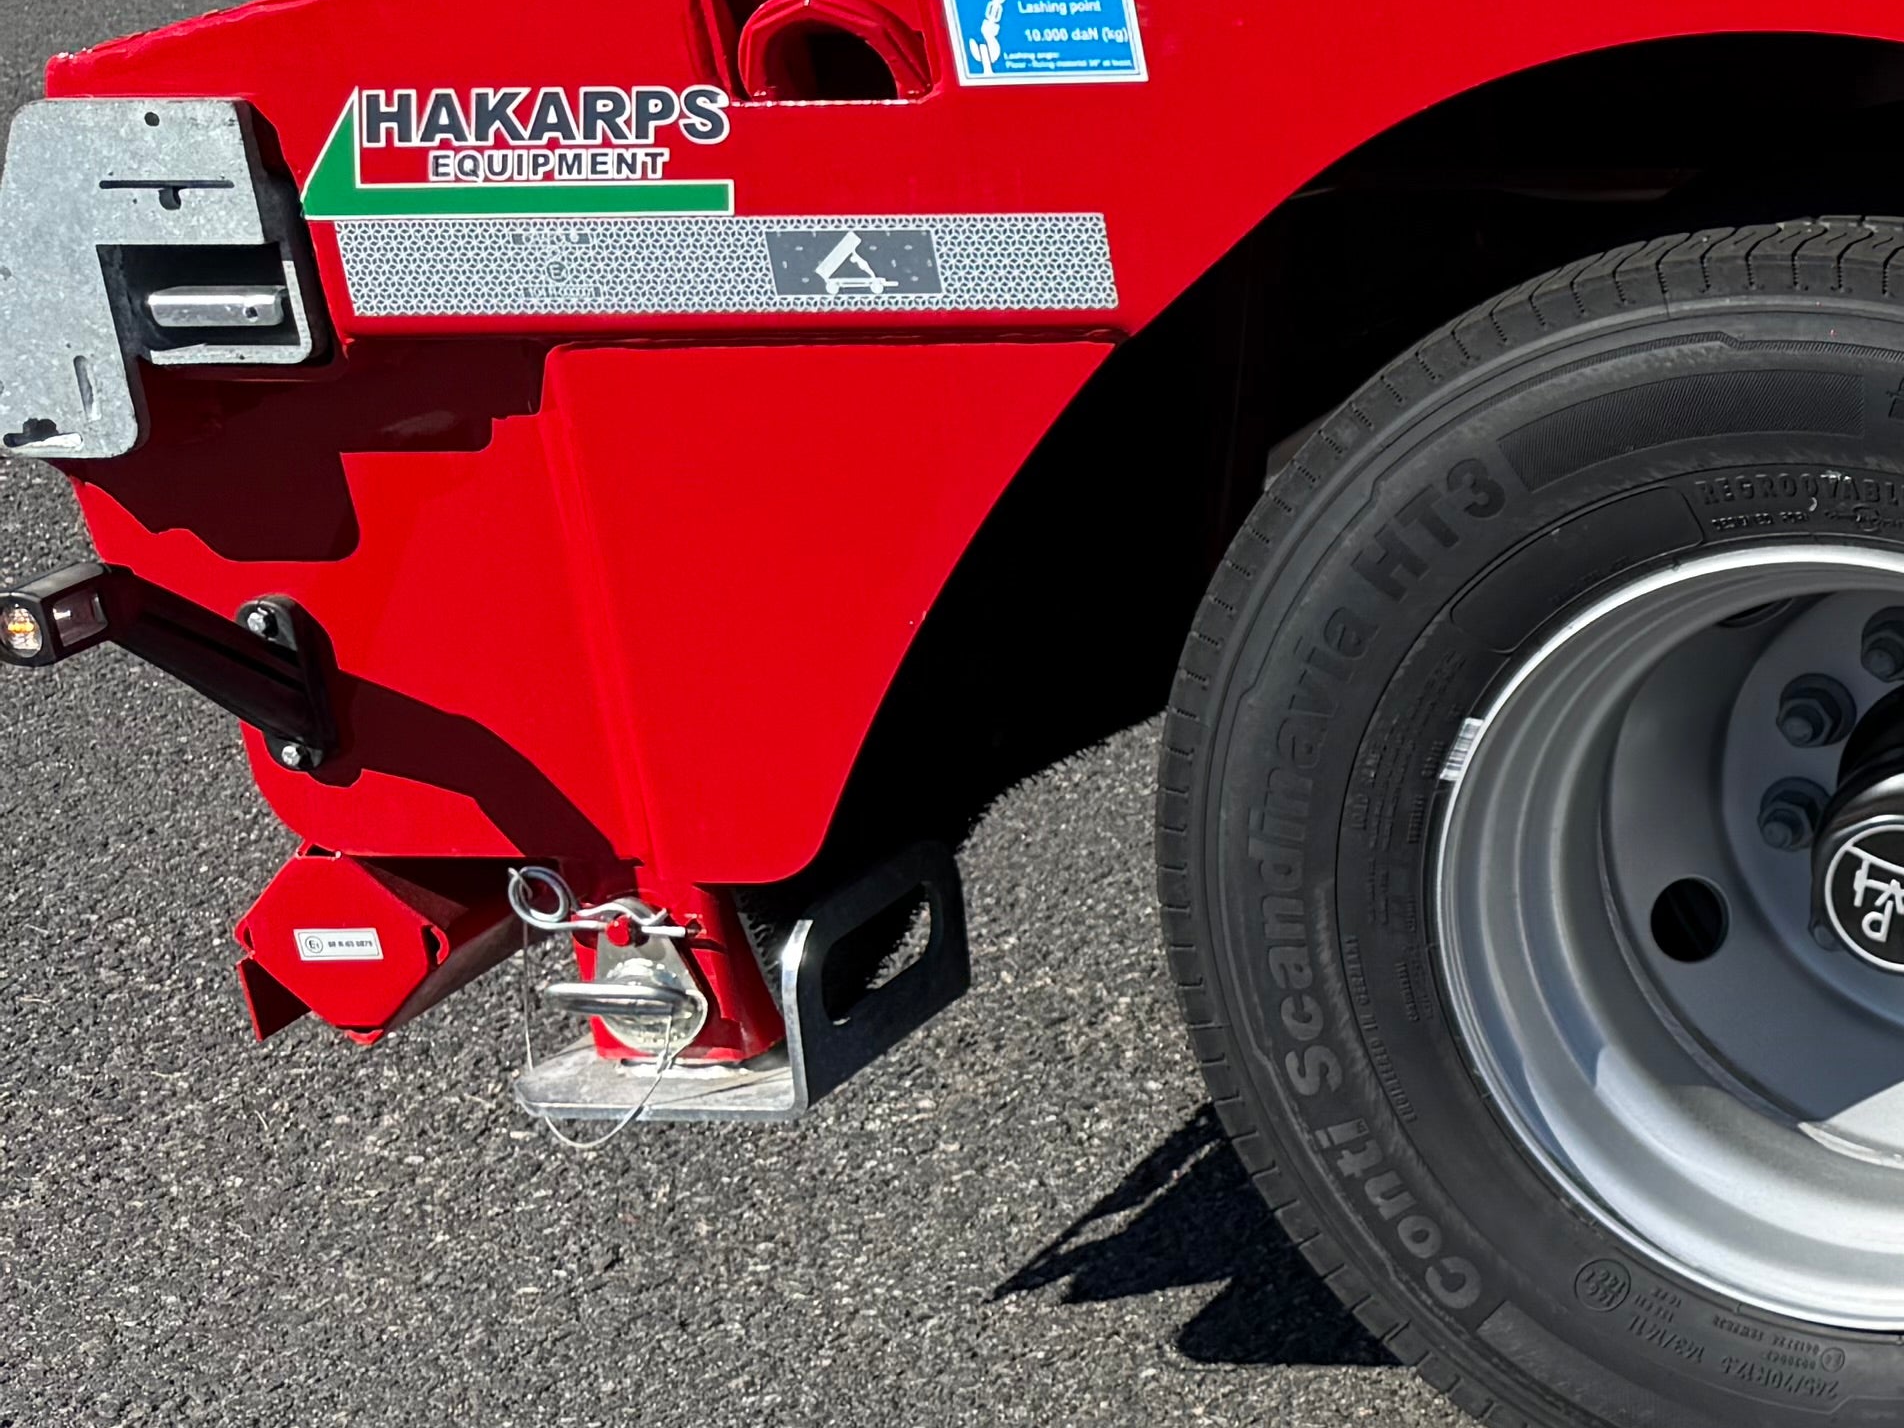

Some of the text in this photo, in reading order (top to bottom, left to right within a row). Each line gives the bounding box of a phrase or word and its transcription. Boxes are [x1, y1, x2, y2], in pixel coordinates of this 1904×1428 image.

[1018, 0, 1102, 15] Lashing point
[1024, 27, 1129, 43] 10.000 daN (kg)
[362, 85, 731, 146] HAKARPS
[429, 148, 669, 181] EQUIPMENT
[1350, 457, 1506, 604] HT3
[1248, 606, 1380, 1096] Scandinavia
[1316, 1118, 1481, 1309] Conti
